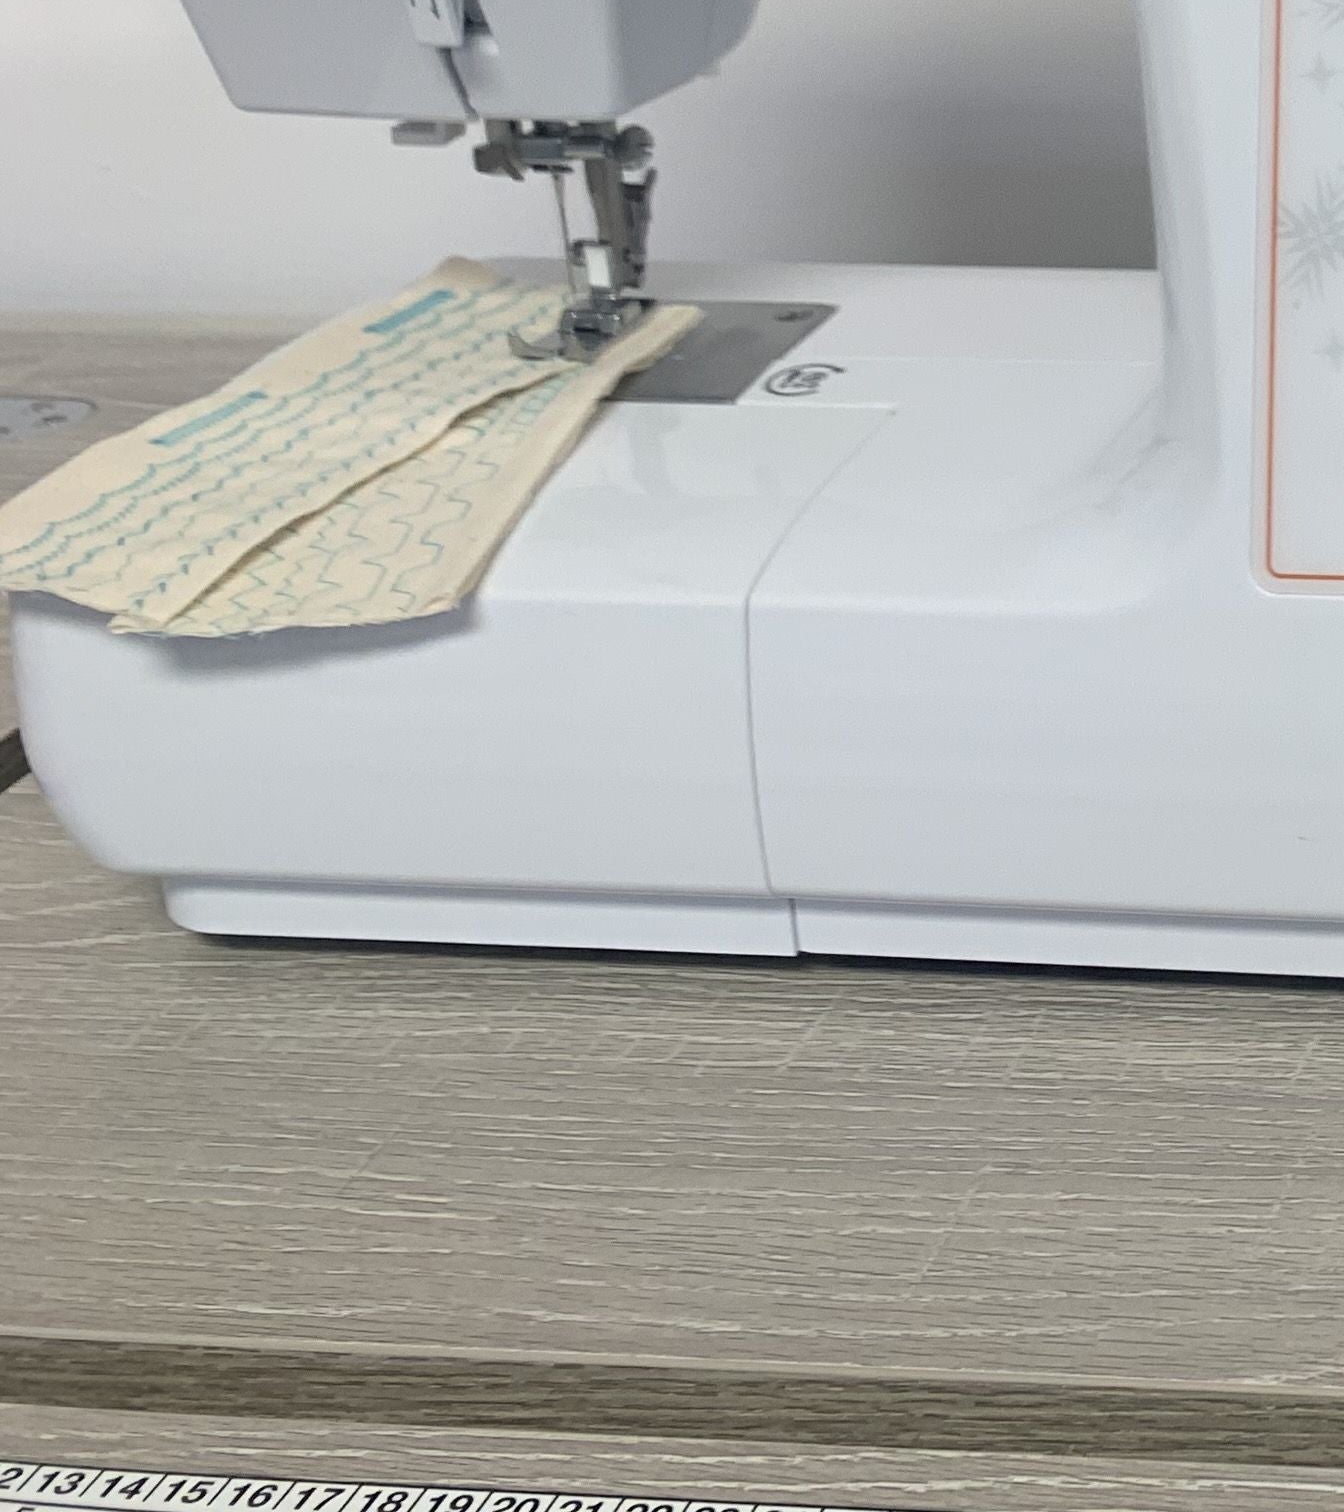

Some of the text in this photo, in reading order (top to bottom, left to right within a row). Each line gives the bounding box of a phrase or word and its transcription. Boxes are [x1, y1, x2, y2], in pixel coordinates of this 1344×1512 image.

[37, 1471, 86, 1494] 13
[100, 1475, 150, 1500] 14
[164, 1479, 215, 1504] 15
[229, 1483, 279, 1508] 16
[294, 1487, 346, 1511] 17
[360, 1490, 409, 1512] 18
[428, 1493, 474, 1512] 19
